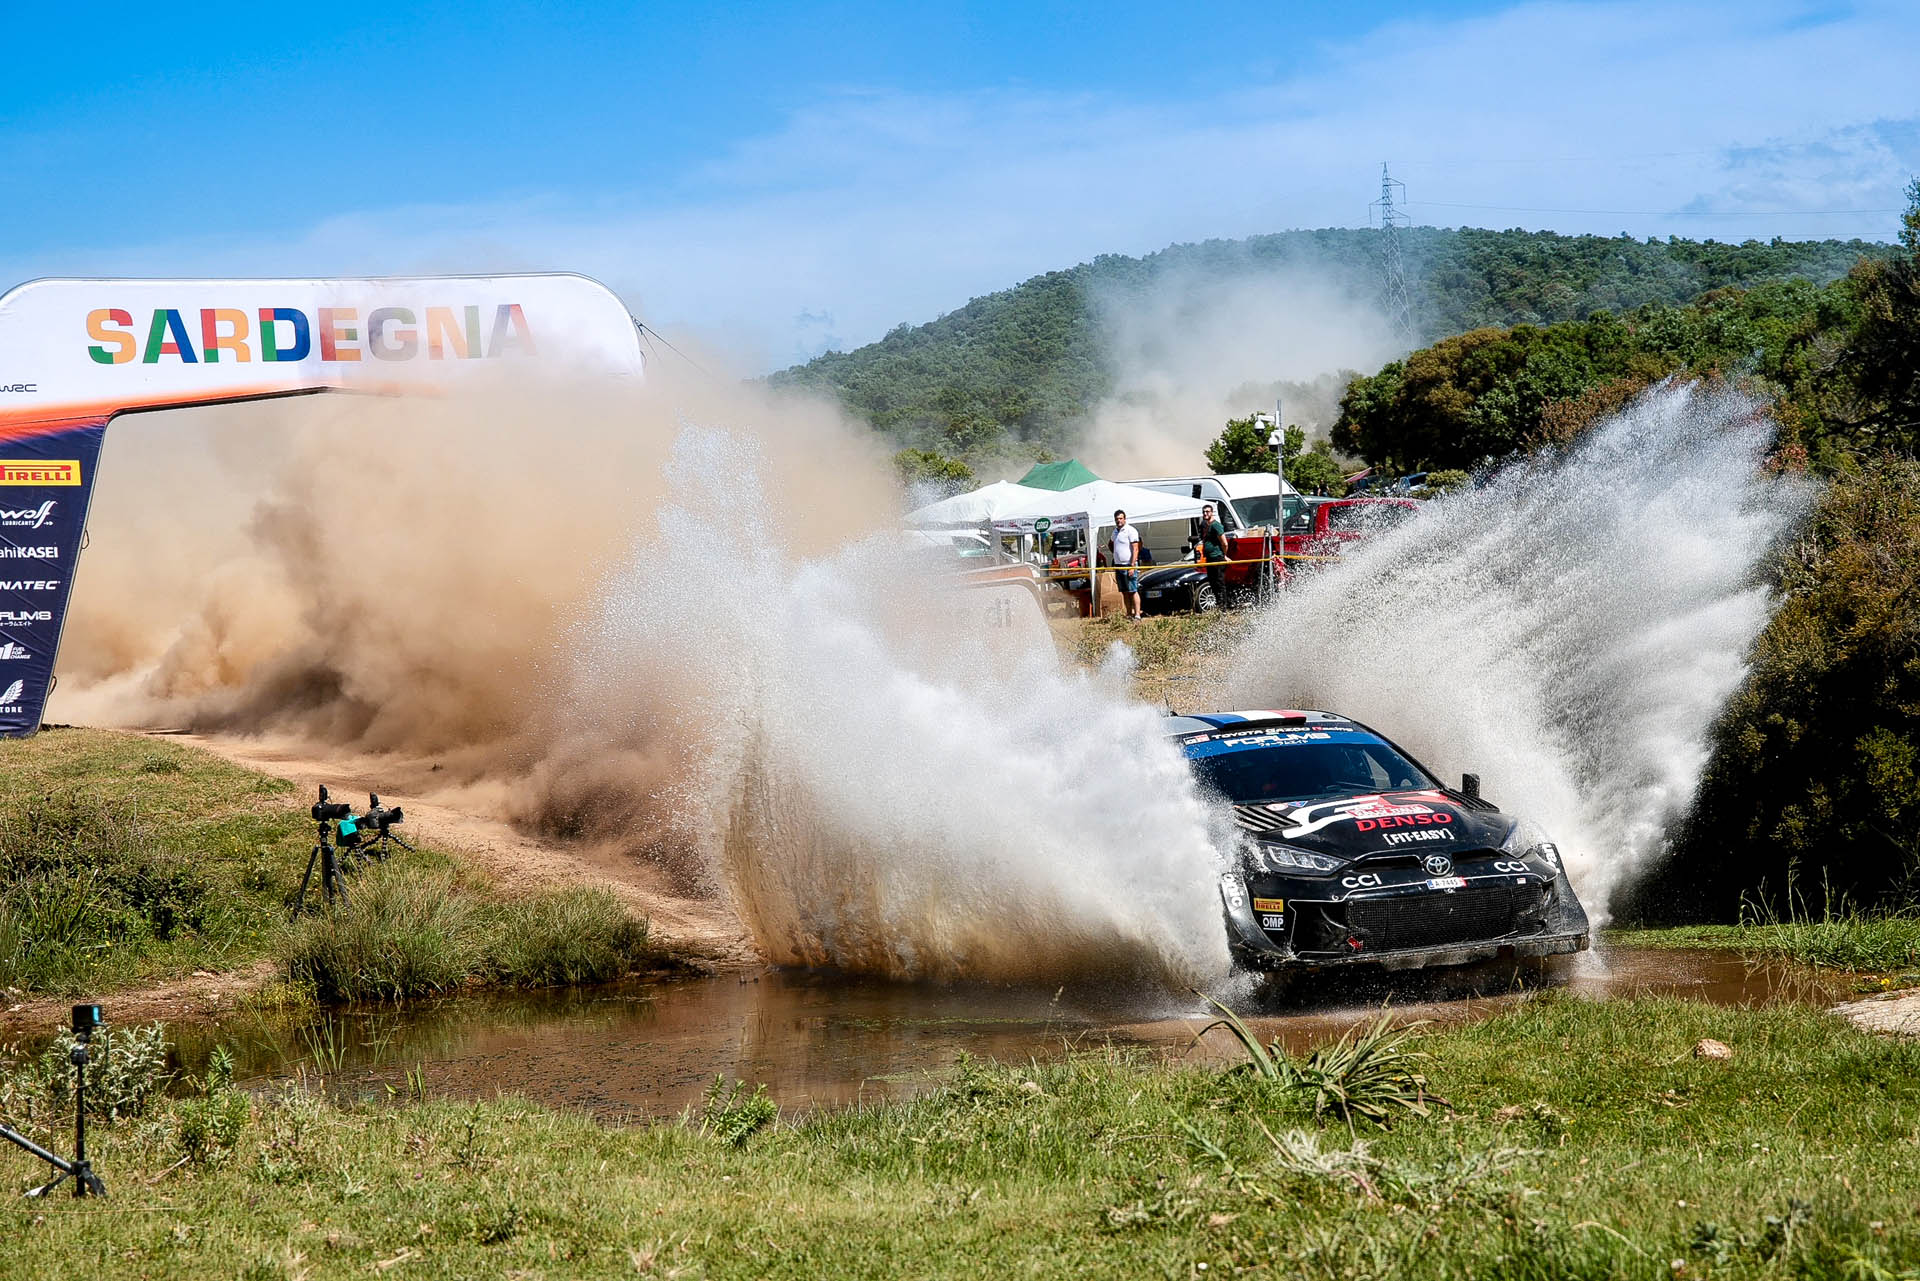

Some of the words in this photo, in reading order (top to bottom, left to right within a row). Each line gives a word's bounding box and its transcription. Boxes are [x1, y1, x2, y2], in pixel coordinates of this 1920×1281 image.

[86, 304, 538, 364] SARDEGNA
[1211, 729, 1264, 740] TOYOTA
[1355, 813, 1453, 832] DENSO
[1494, 861, 1530, 873] CCI
[1341, 873, 1382, 889] CCI
[1255, 900, 1281, 910] PIRELLI
[1263, 917, 1284, 928] OMP
